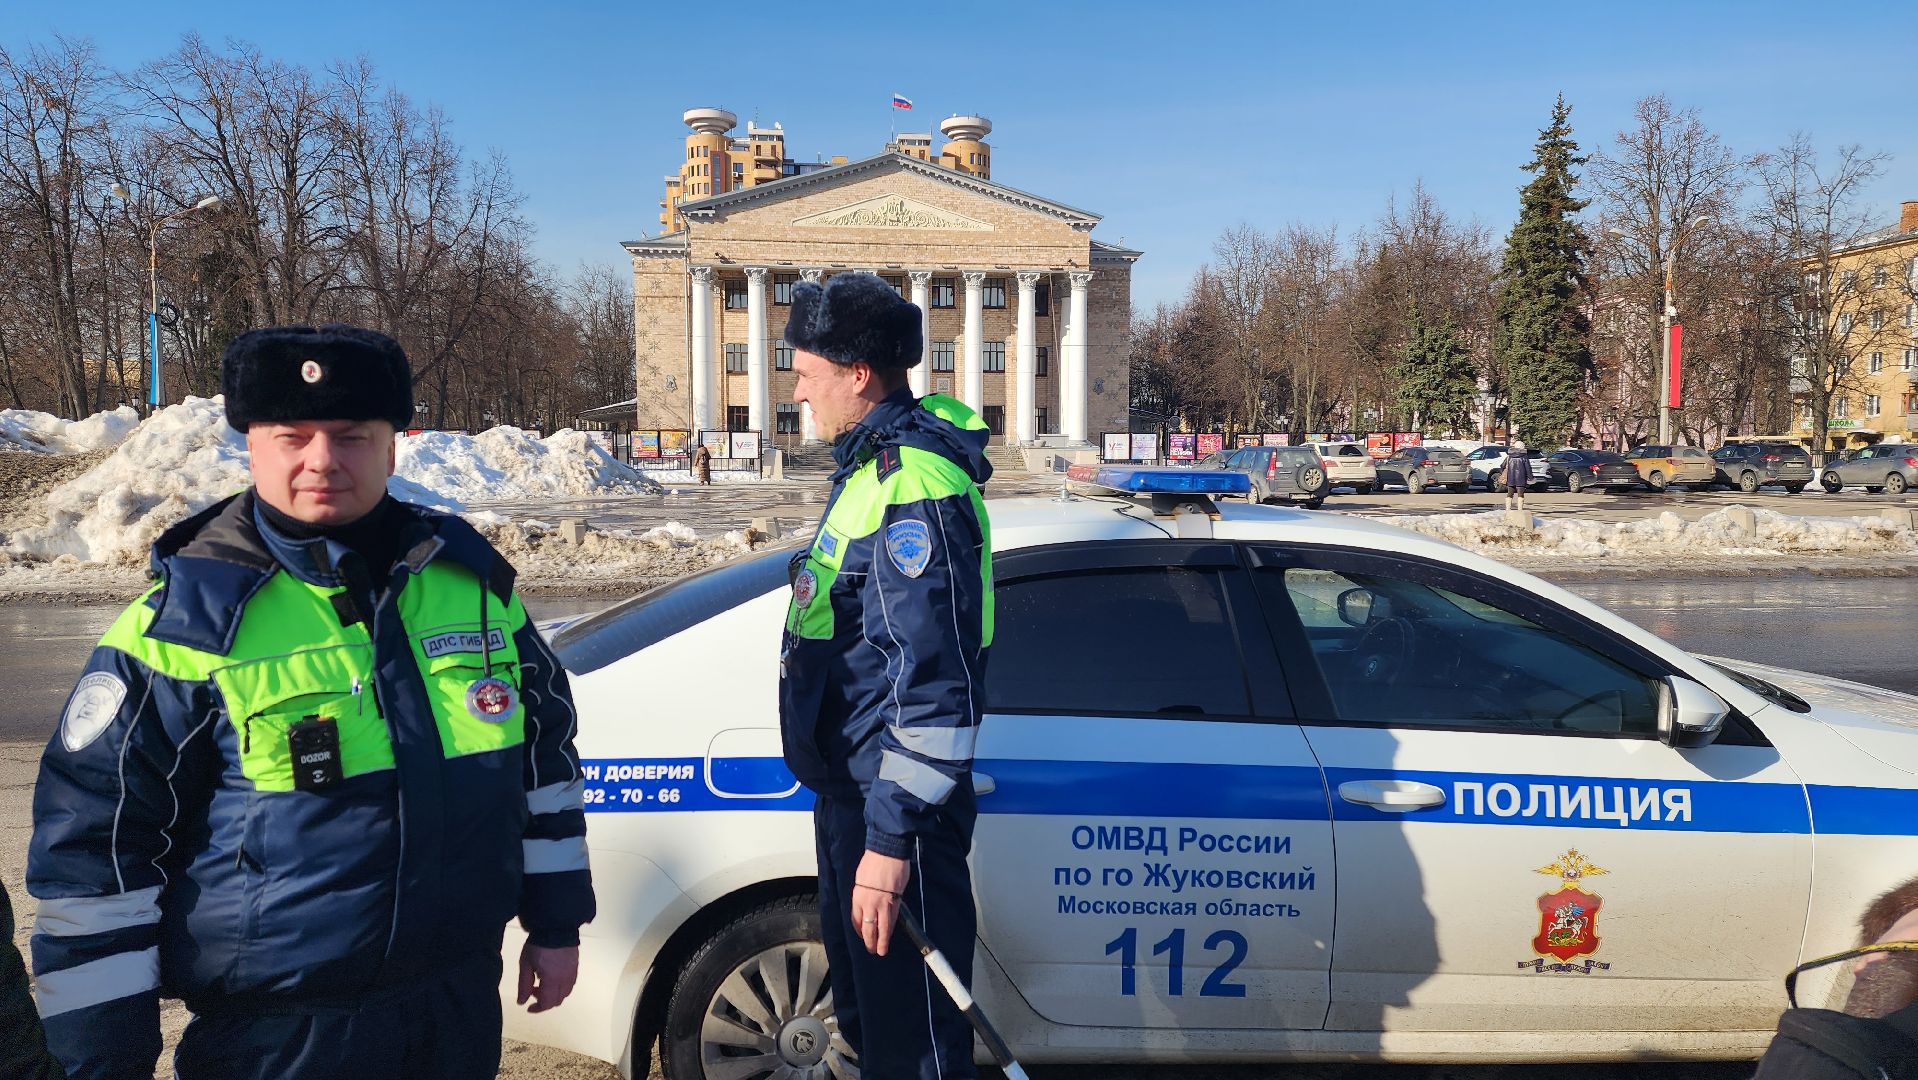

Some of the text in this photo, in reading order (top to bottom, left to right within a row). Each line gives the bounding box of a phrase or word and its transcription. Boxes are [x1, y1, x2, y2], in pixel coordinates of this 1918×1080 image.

[428, 636, 457, 653] ДПС
[300, 751, 331, 764] DOZOR
[603, 765, 695, 782] ДОВЕРИЯ
[620, 788, 644, 804] 70
[657, 788, 681, 803] 66
[1453, 781, 1693, 827] ПОЛИЦИЯ
[1071, 825, 1291, 856] ОМВД России
[1054, 862, 1316, 893] по го Жуковский
[1058, 895, 1301, 918] Московская область
[1105, 927, 1249, 998] 112
